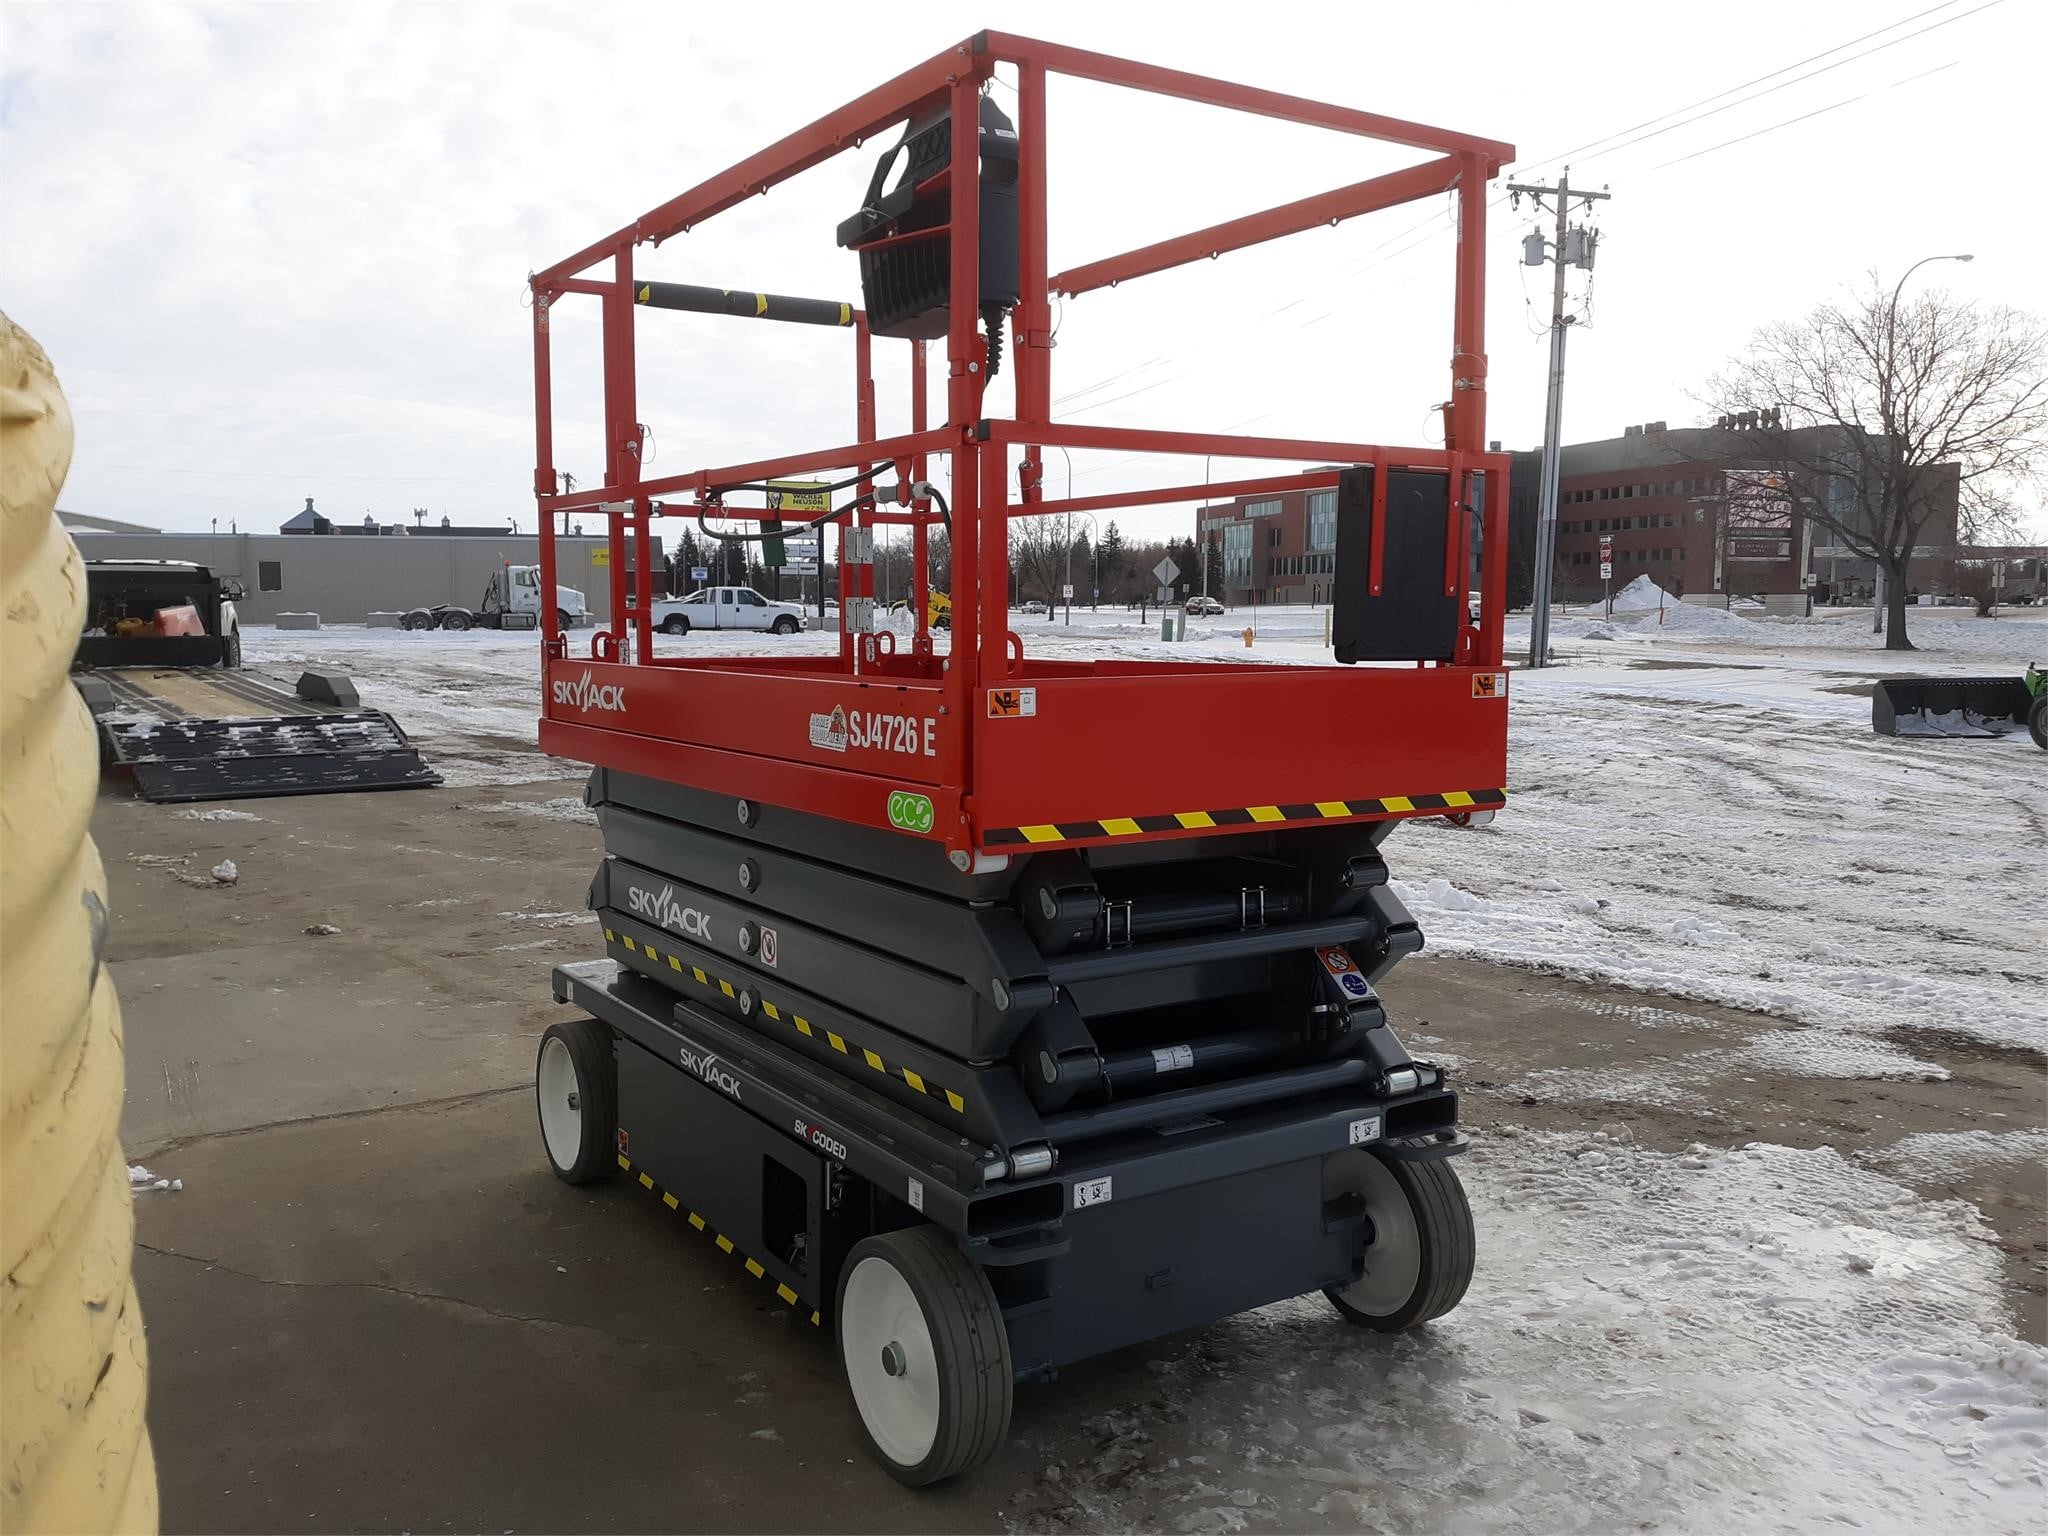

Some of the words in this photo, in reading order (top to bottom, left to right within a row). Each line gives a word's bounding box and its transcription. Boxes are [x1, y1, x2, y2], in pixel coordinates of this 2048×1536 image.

[553, 667, 627, 712] SKYJACK
[849, 710, 918, 754] SJ4726
[923, 717, 936, 757] E
[628, 884, 713, 942] SKYJACK
[680, 1047, 742, 1100] SKYJACK
